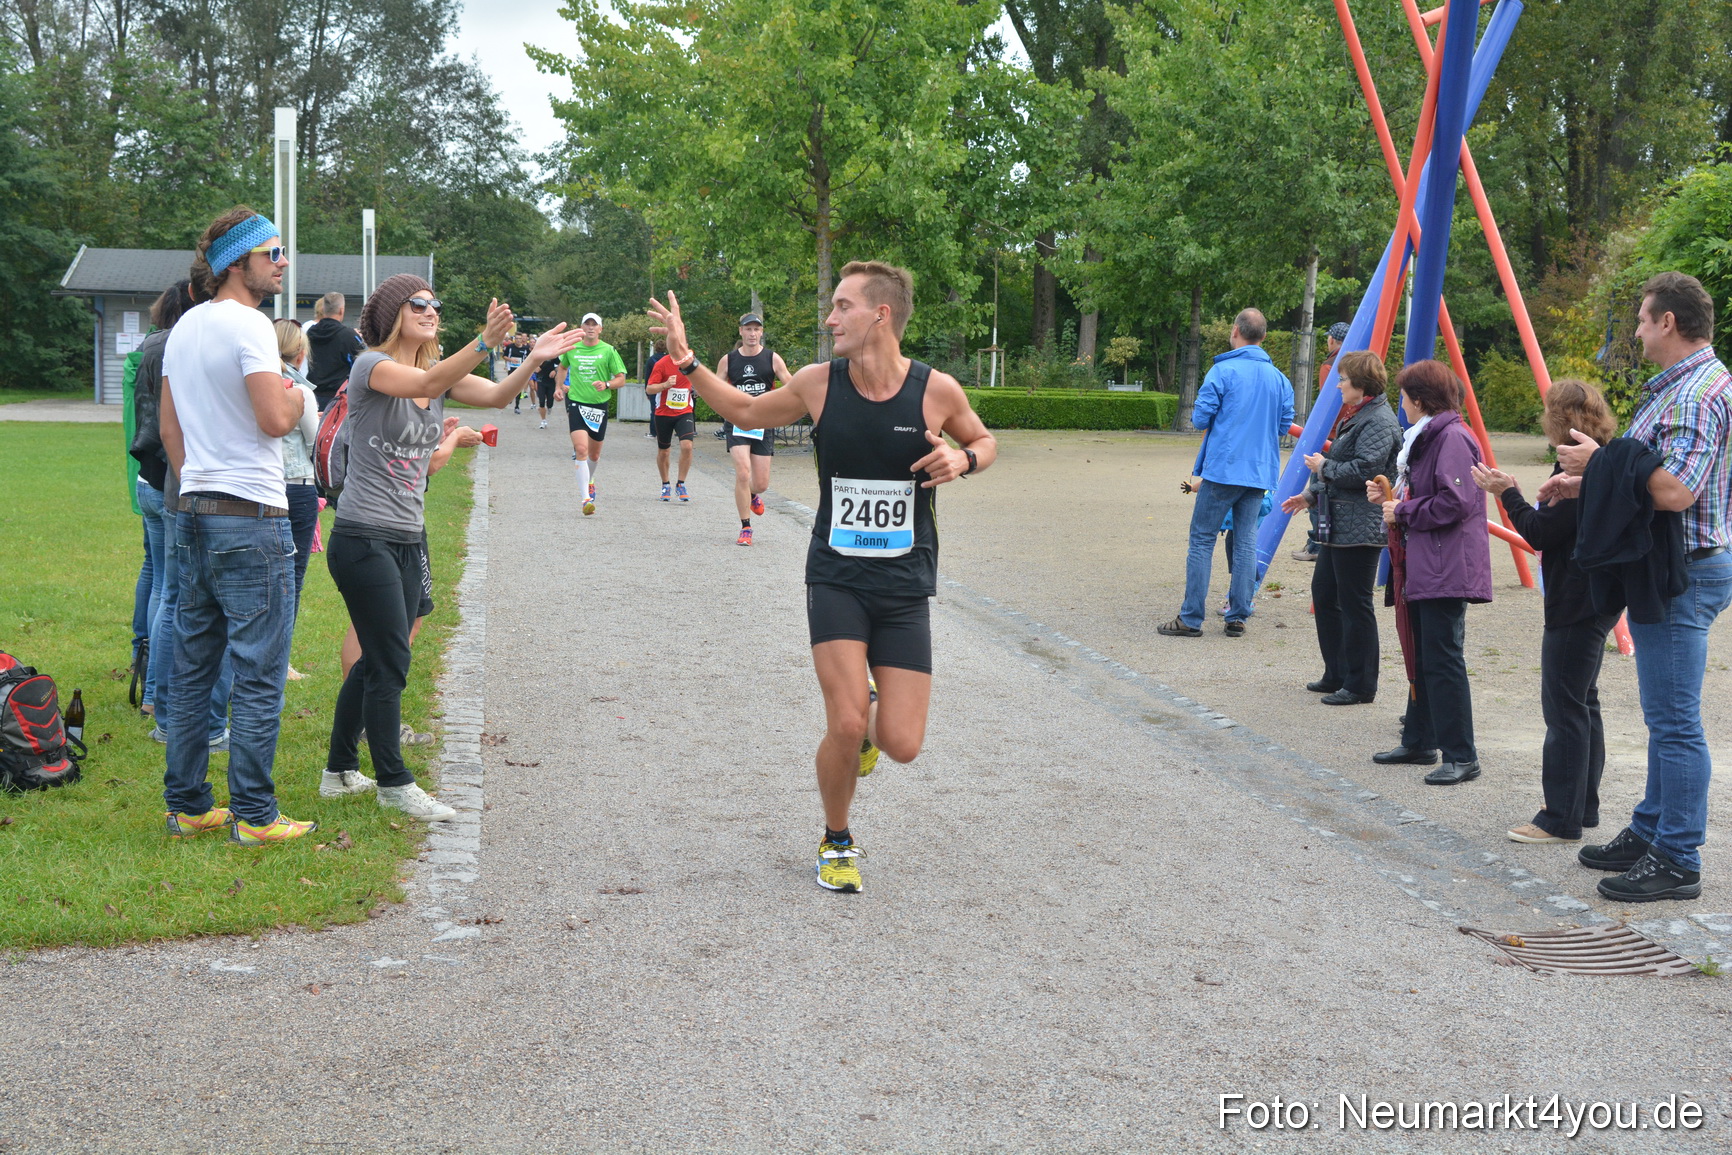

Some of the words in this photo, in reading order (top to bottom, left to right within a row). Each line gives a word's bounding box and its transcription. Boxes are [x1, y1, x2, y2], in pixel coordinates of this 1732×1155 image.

[671, 393, 686, 402] 293
[397, 421, 441, 445] NO
[834, 485, 860, 495] PARTL
[861, 487, 902, 496] Neumarkt
[840, 497, 907, 528] 2469
[854, 534, 889, 549] Ronny
